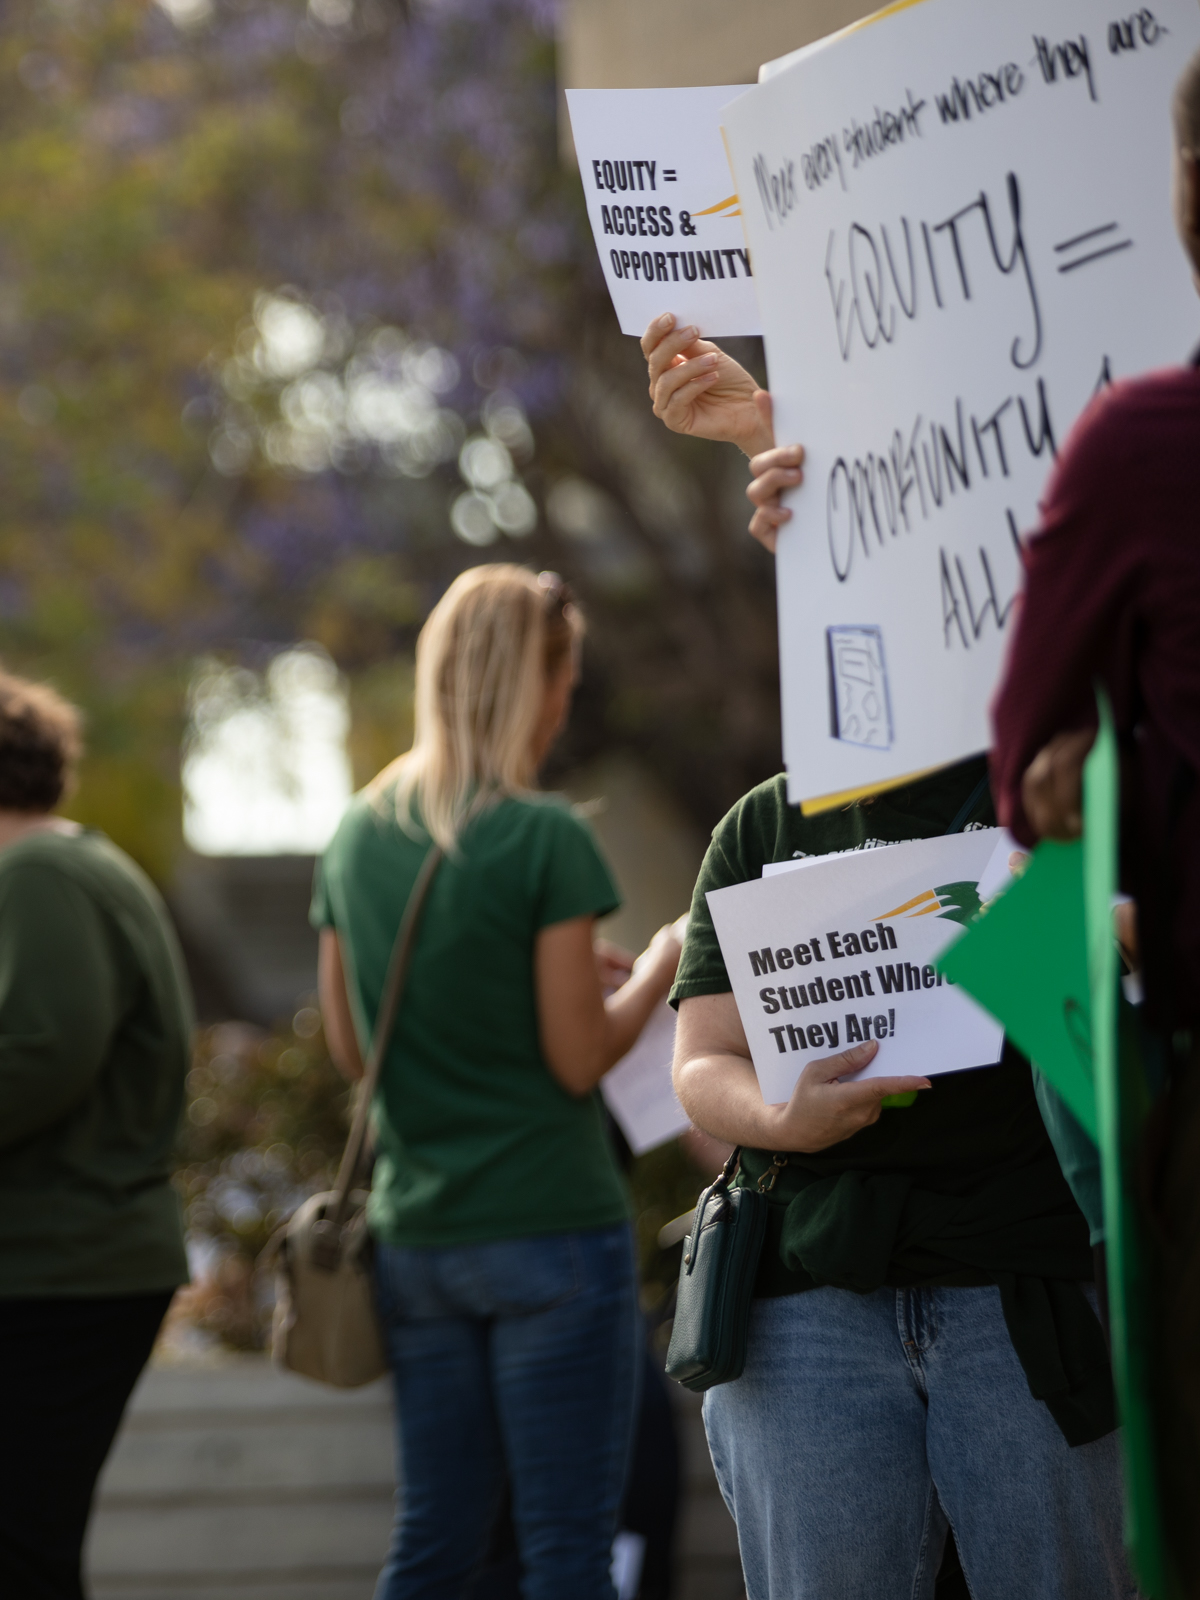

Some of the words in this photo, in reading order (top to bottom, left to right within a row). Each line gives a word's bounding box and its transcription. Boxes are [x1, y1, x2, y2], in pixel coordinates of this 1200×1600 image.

[801, 132, 848, 193] every
[843, 88, 927, 170] student
[935, 62, 1025, 124] where
[1029, 33, 1101, 103] they
[591, 159, 657, 194] EQUITY
[662, 169, 678, 182] =
[601, 204, 675, 237] ACCESS
[678, 210, 697, 236] &
[610, 247, 753, 282] OPPORTUNITY
[747, 937, 826, 977] Meet
[826, 922, 898, 963] Each
[758, 969, 876, 1015] Student
[768, 1020, 840, 1054] They
[845, 1008, 896, 1045] Are!
